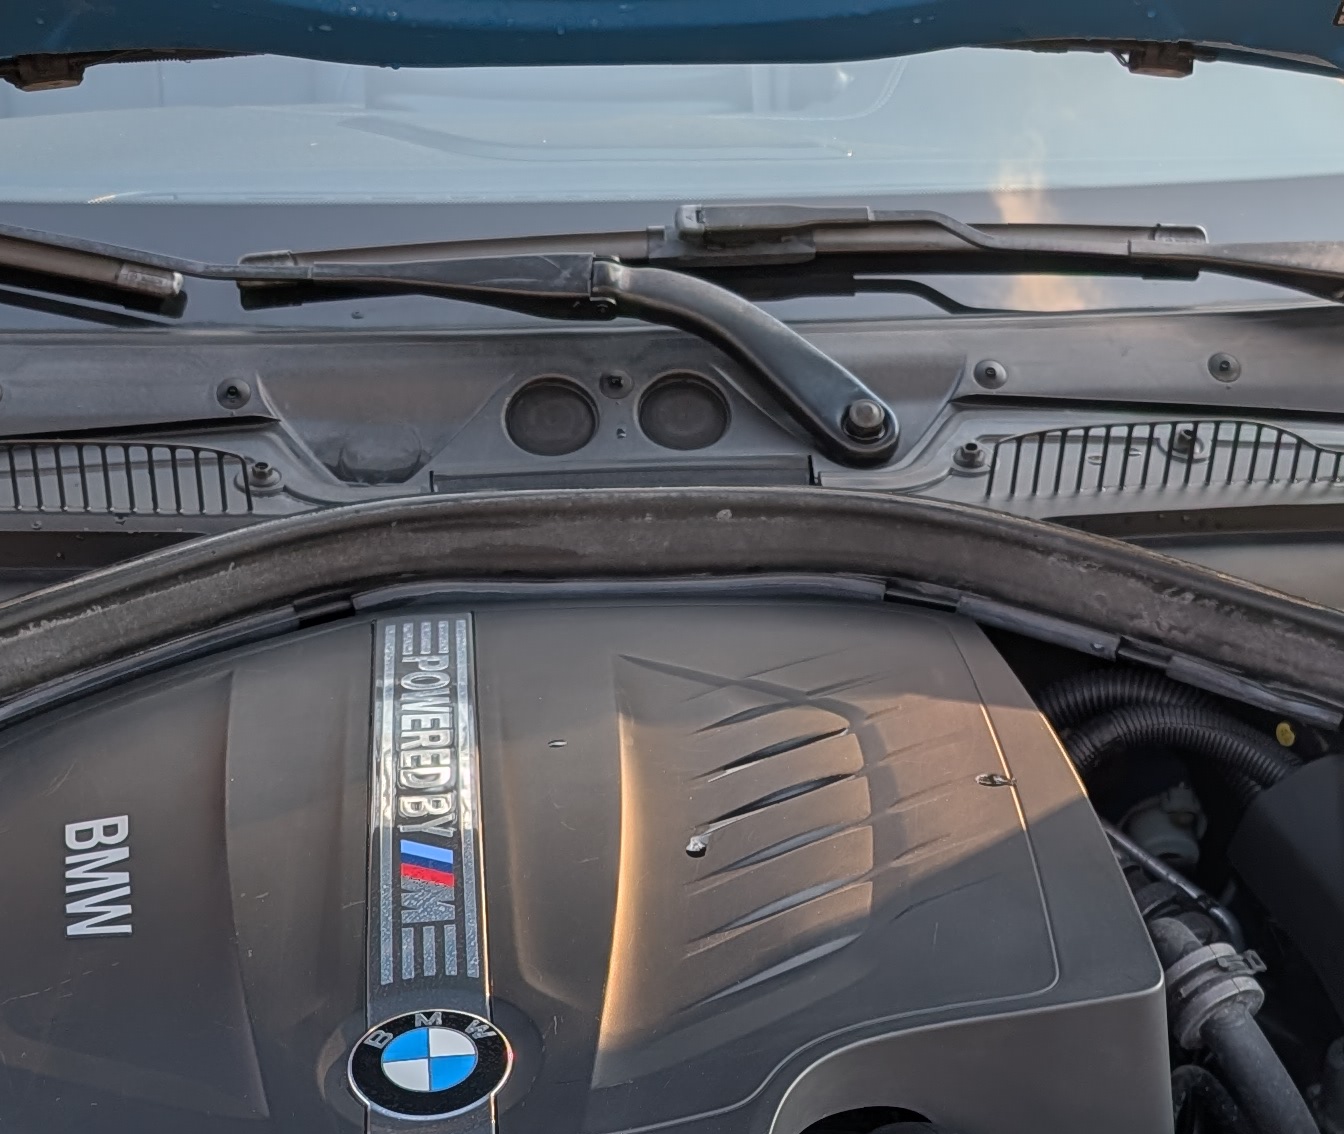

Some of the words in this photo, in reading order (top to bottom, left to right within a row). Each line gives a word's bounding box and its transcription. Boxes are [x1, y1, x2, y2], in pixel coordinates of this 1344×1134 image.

[399, 655, 455, 790] POWERED
[398, 795, 457, 838] BY
[64, 814, 133, 936] BMW
[363, 1011, 498, 1049] BMW
